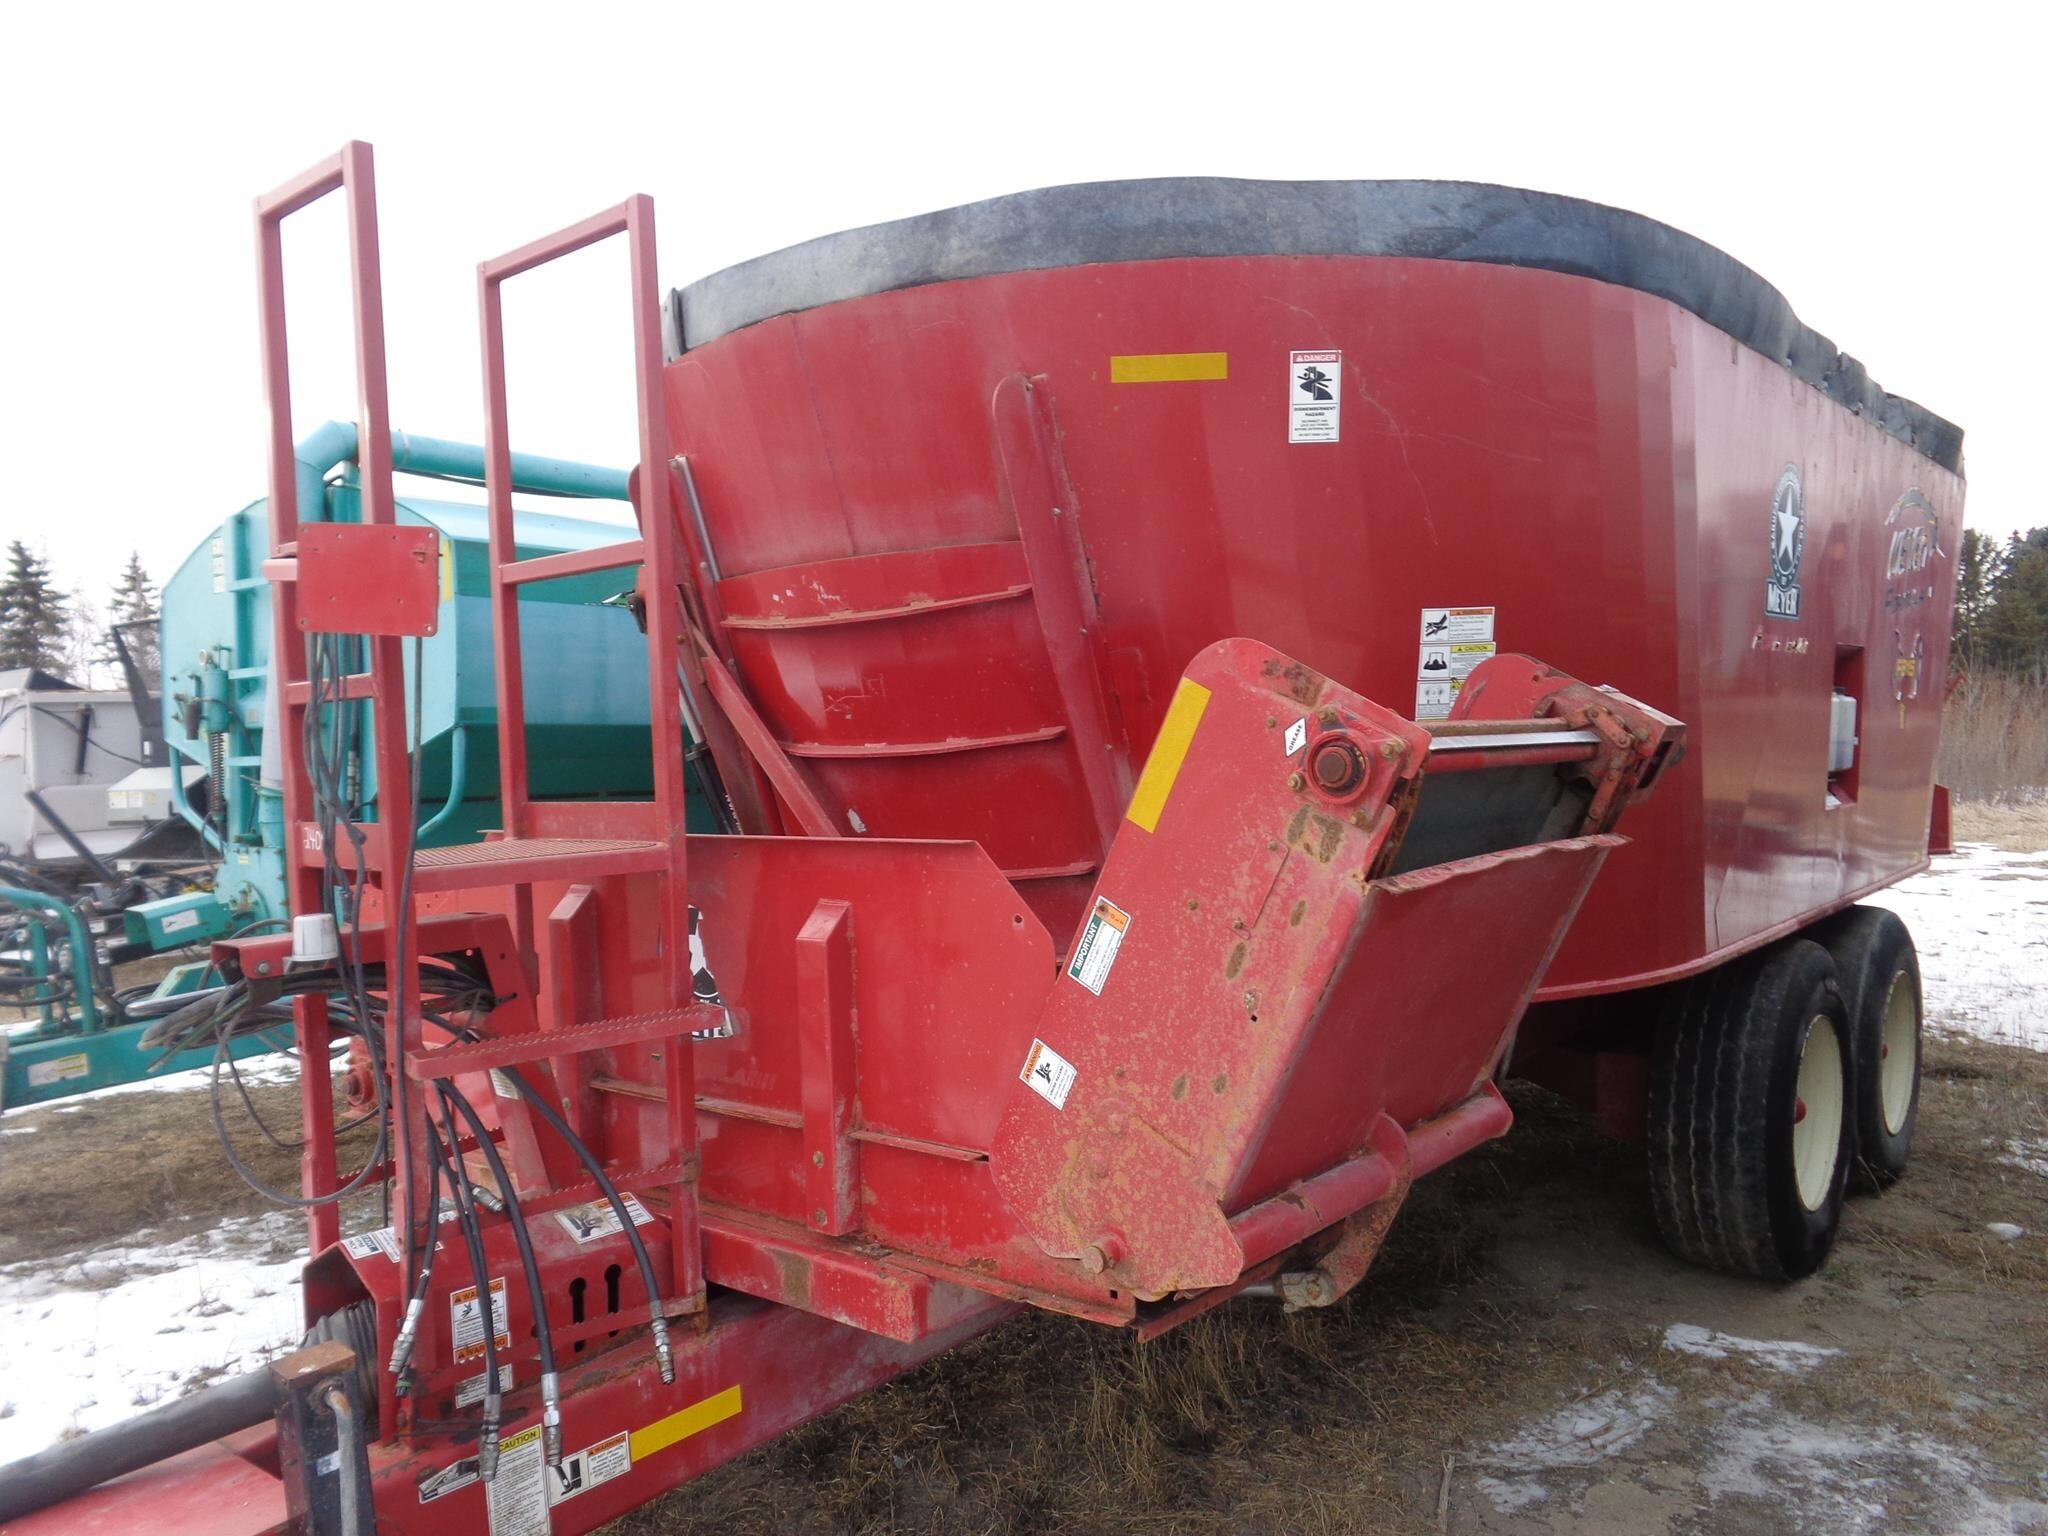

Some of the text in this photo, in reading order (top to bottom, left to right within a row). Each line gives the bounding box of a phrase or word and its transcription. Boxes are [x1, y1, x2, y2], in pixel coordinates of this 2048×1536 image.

[1767, 582, 1797, 615] MEYER
[1074, 922, 1098, 970] IMPORTANT
[499, 1430, 537, 1450] CAUTION
